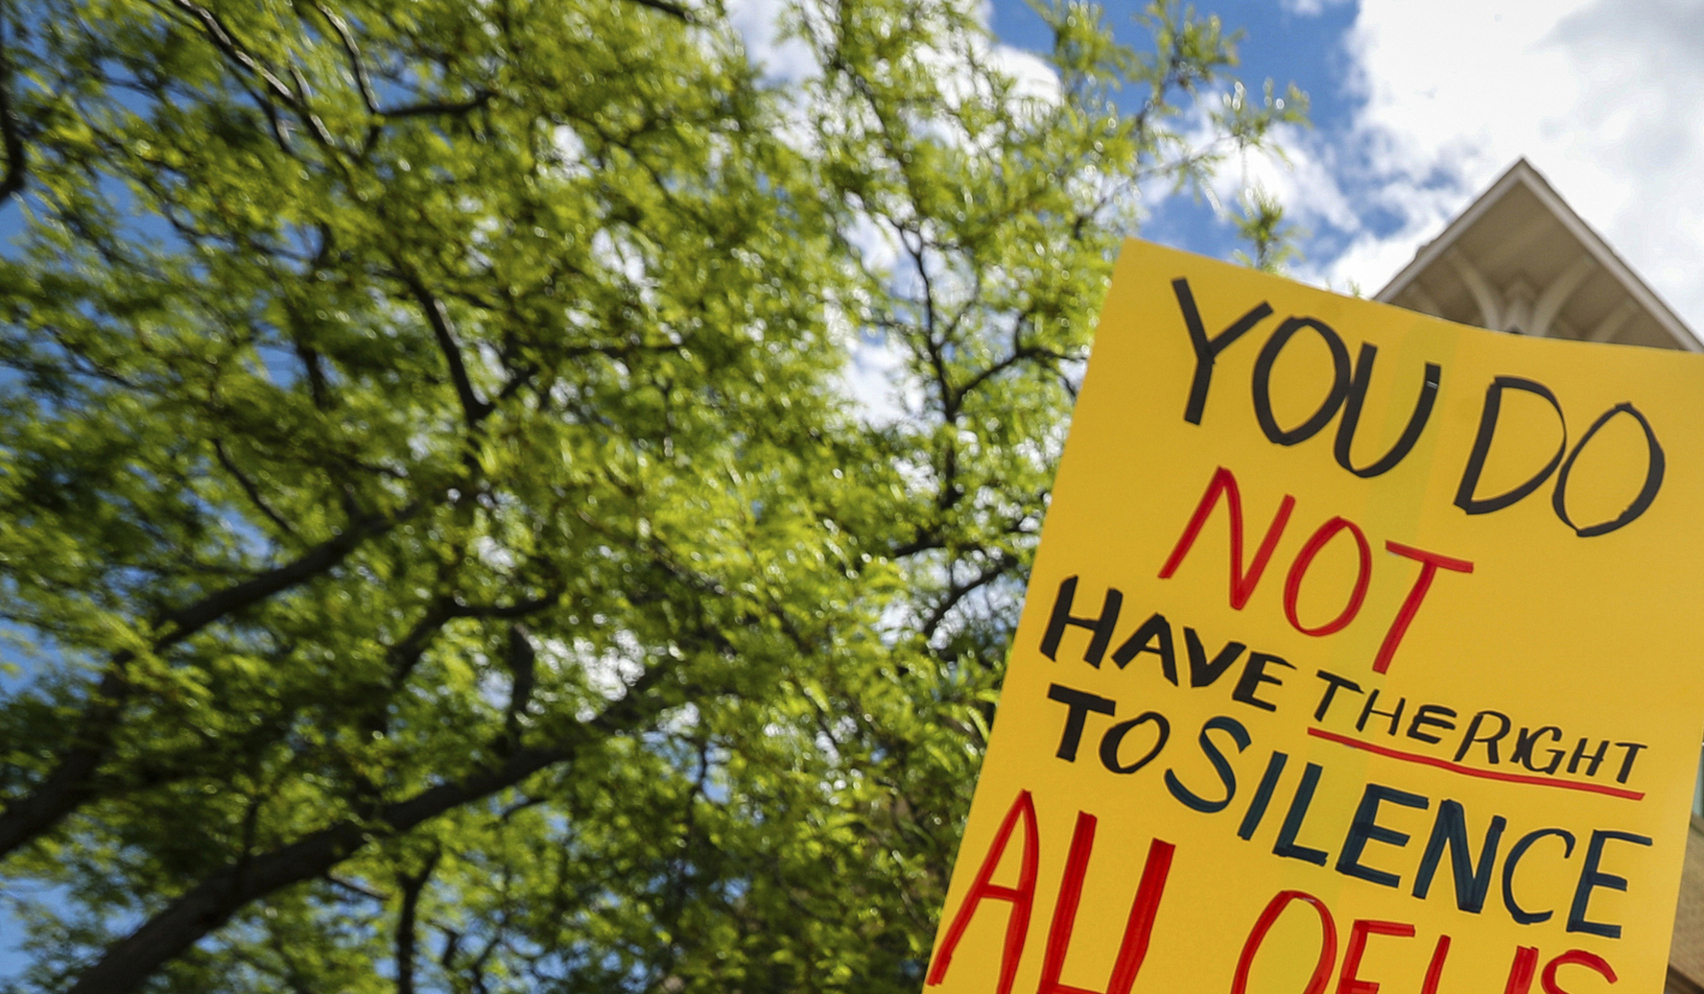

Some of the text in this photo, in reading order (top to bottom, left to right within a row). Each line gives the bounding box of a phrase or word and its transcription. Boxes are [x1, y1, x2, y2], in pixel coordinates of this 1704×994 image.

[1171, 277, 1665, 538] YOU DO
[1039, 575, 1649, 784] HAVE THE RIGHT
[1157, 465, 1474, 675] NOT
[1046, 683, 1653, 939] TO SILENCE
